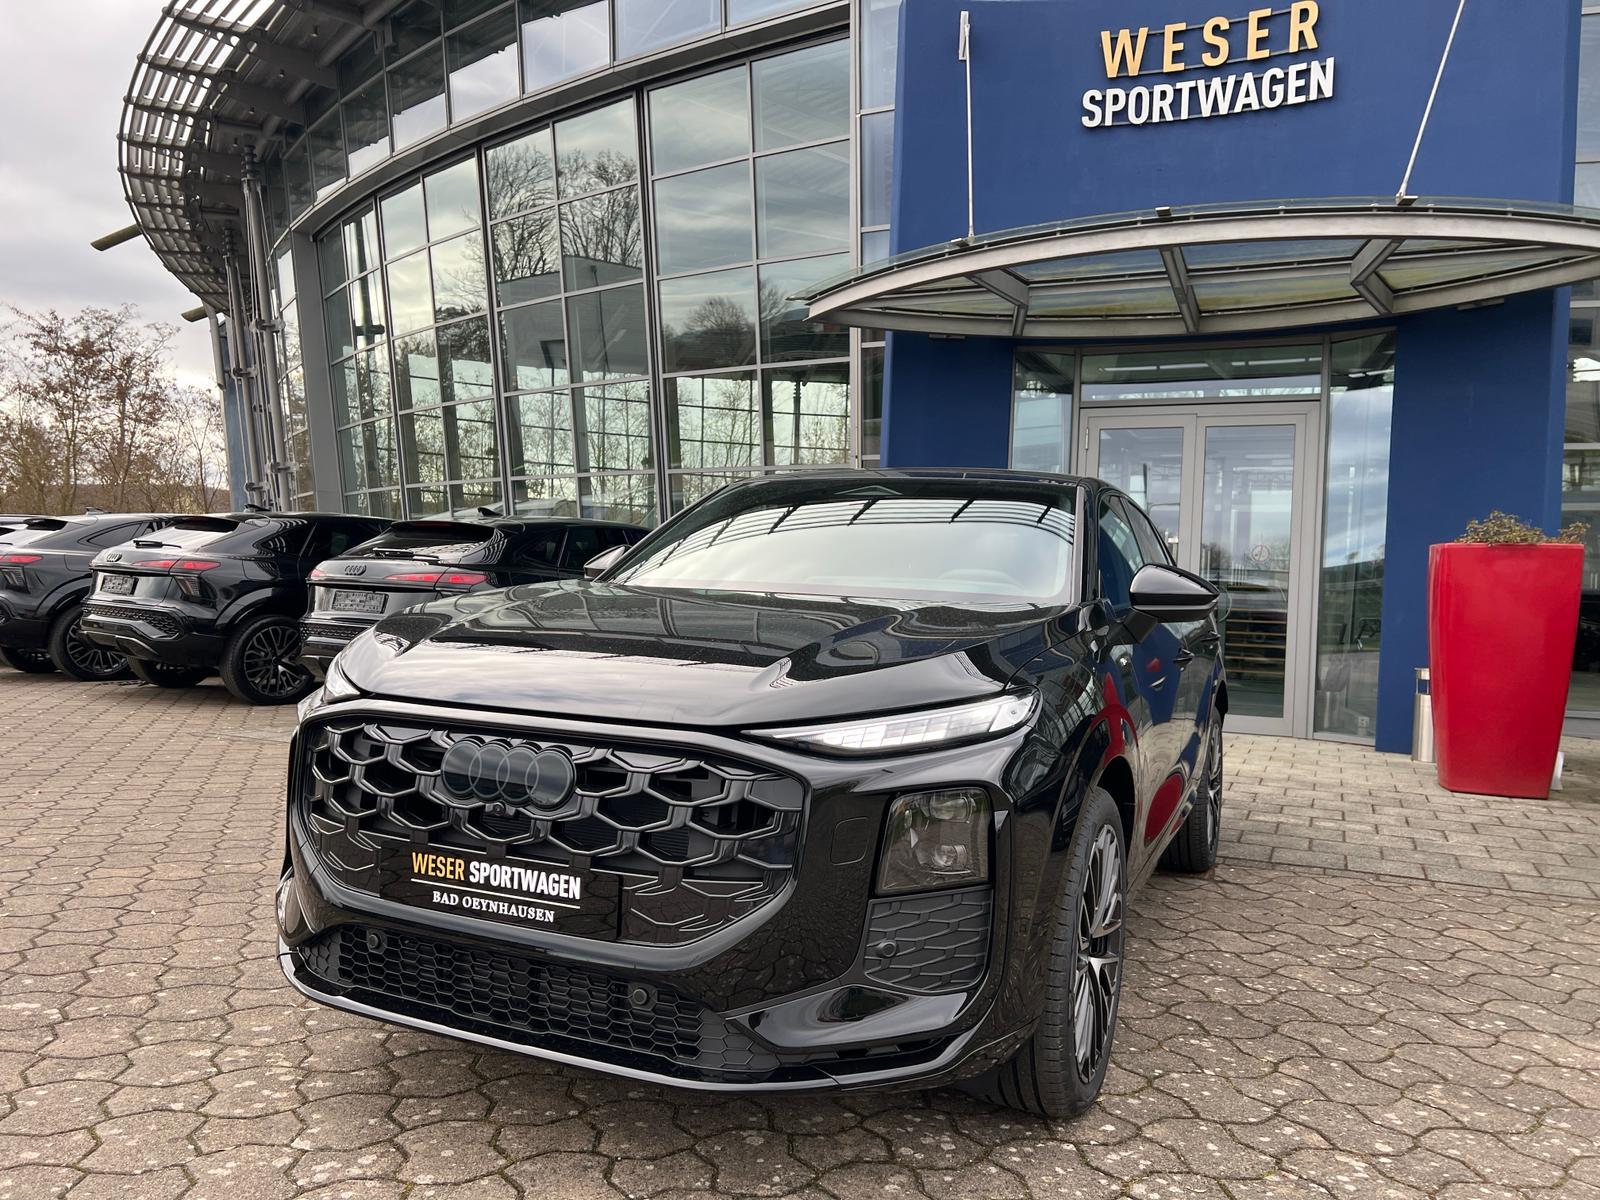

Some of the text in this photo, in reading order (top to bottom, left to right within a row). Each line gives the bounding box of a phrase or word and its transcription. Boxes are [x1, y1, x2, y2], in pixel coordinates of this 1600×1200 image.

[1101, 0, 1319, 78] WESER
[1081, 57, 1335, 128] SPORTWAGEN
[412, 852, 581, 900] WESER SPORTWAGEN
[432, 891, 555, 923] BAD OEYNHAUSEN
